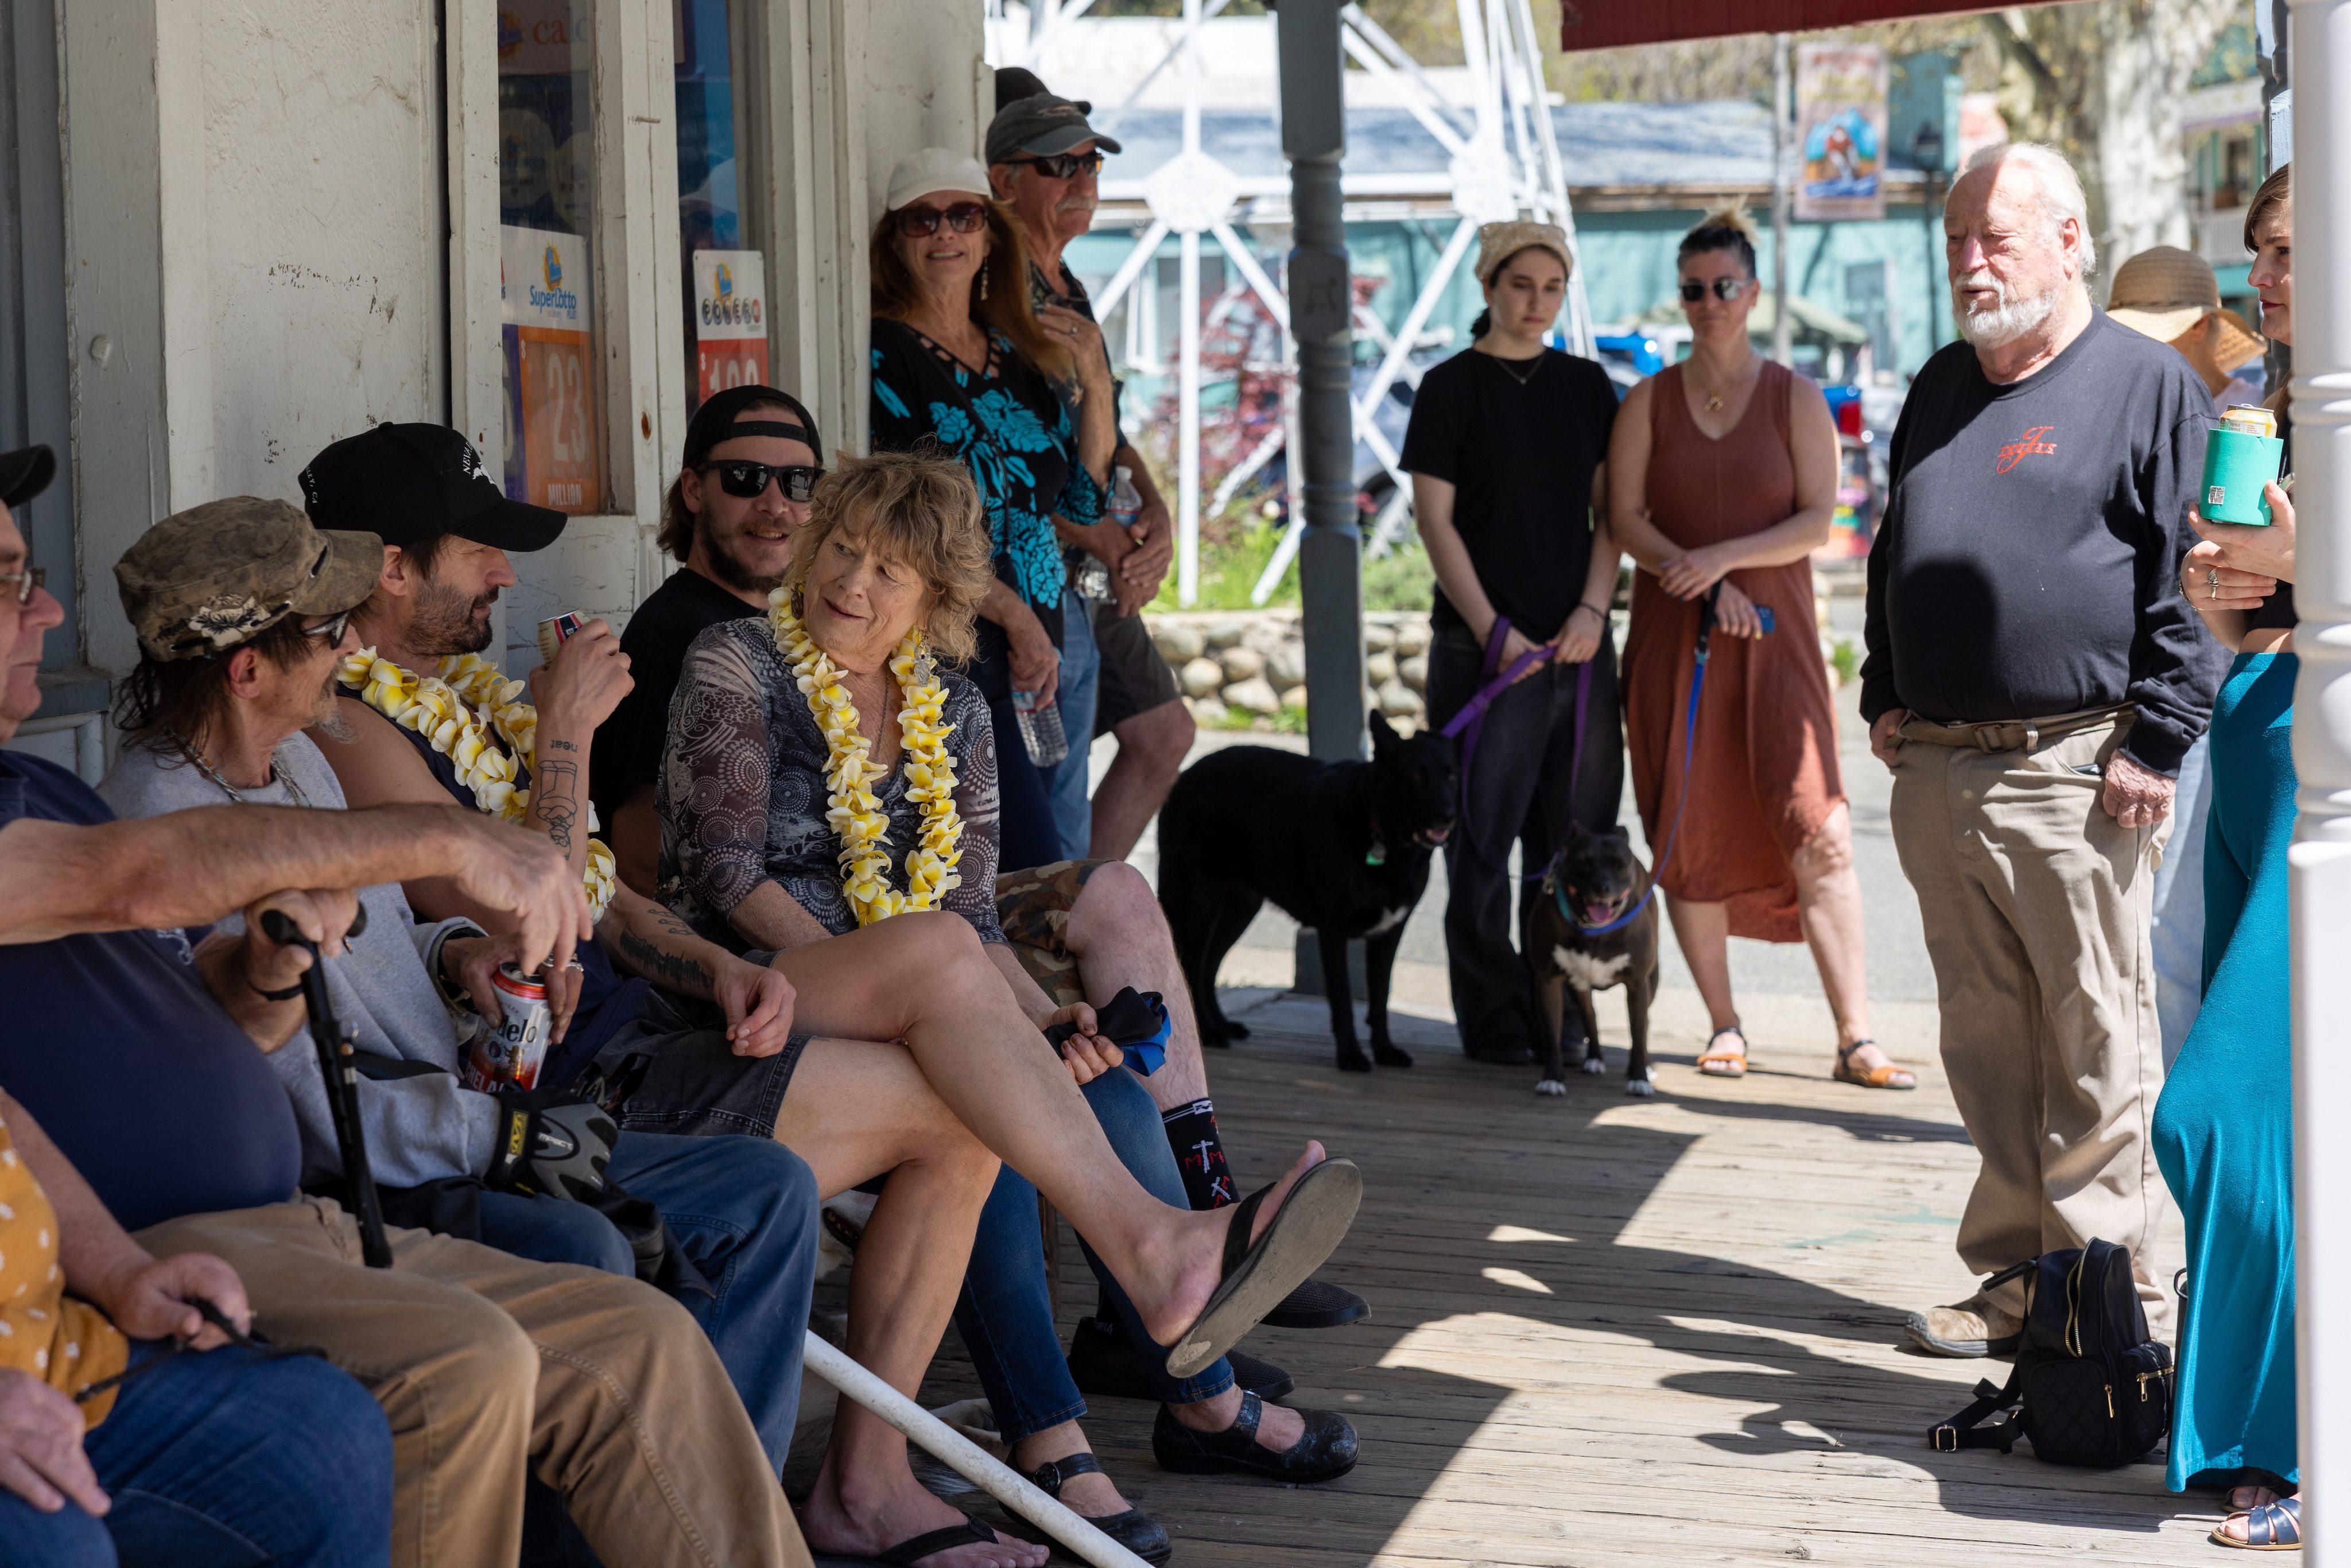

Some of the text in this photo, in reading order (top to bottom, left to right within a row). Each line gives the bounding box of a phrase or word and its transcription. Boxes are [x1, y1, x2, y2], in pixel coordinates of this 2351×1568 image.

[530, 285, 576, 313] SuperLotto
[548, 352, 588, 463] 23
[548, 484, 582, 506] MILLION
[550, 740, 578, 752] neat
